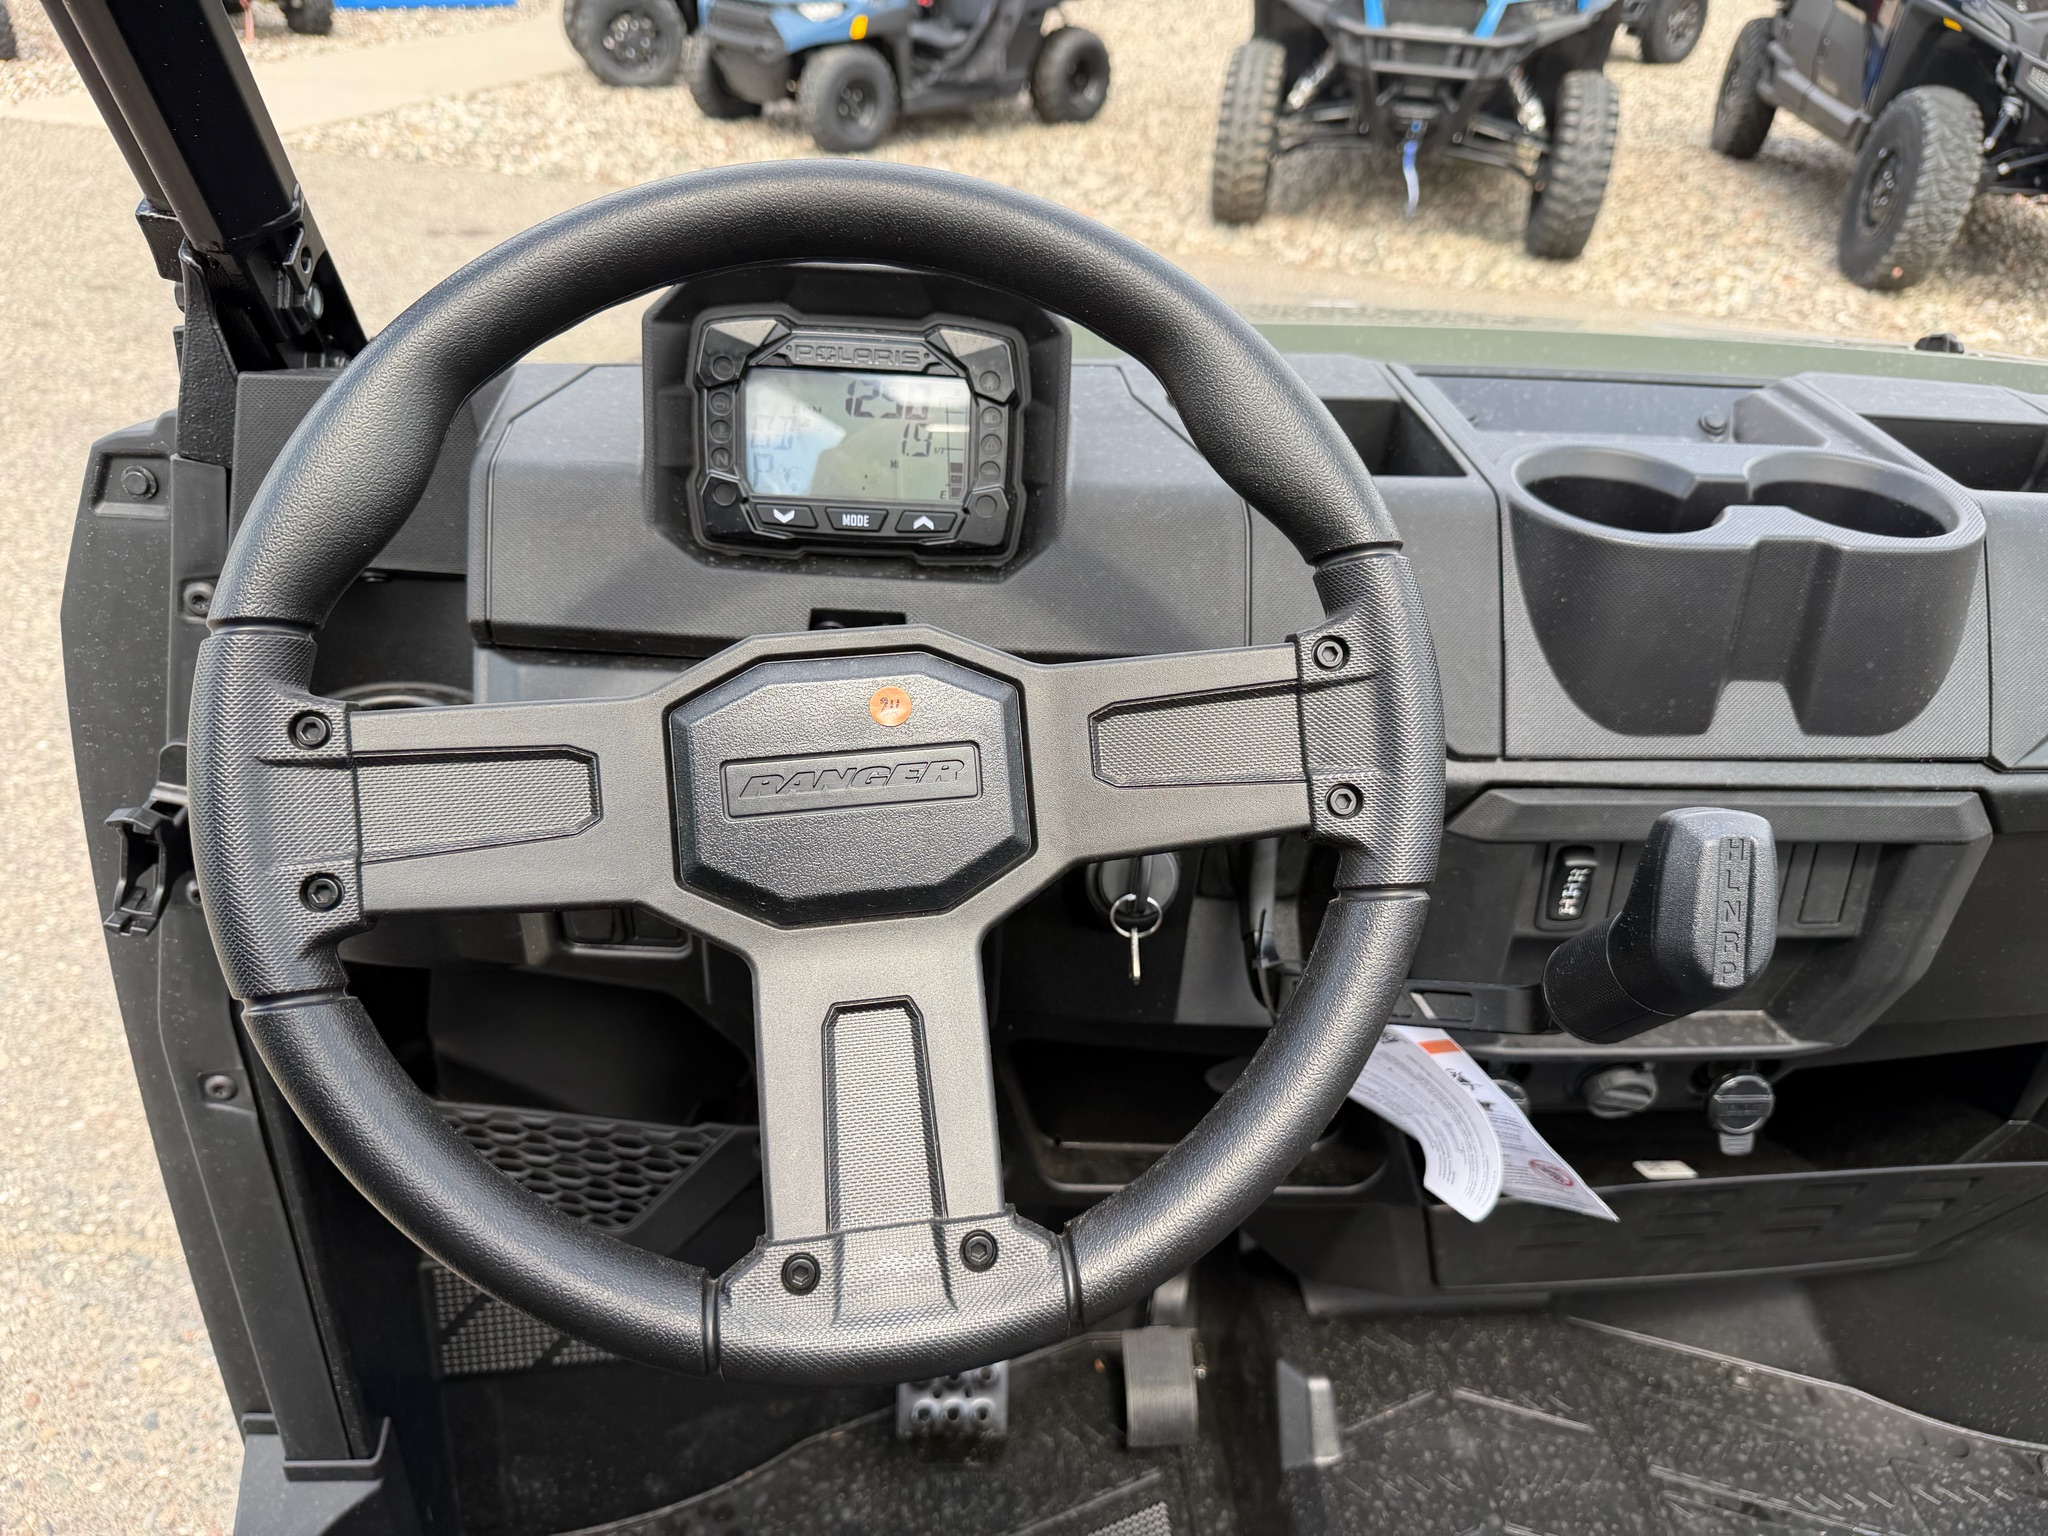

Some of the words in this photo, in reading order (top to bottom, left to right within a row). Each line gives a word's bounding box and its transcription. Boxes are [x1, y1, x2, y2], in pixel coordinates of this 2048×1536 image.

[795, 344, 920, 366] POLARIS
[841, 513, 870, 527] MODE
[739, 759, 965, 799] RANGER
